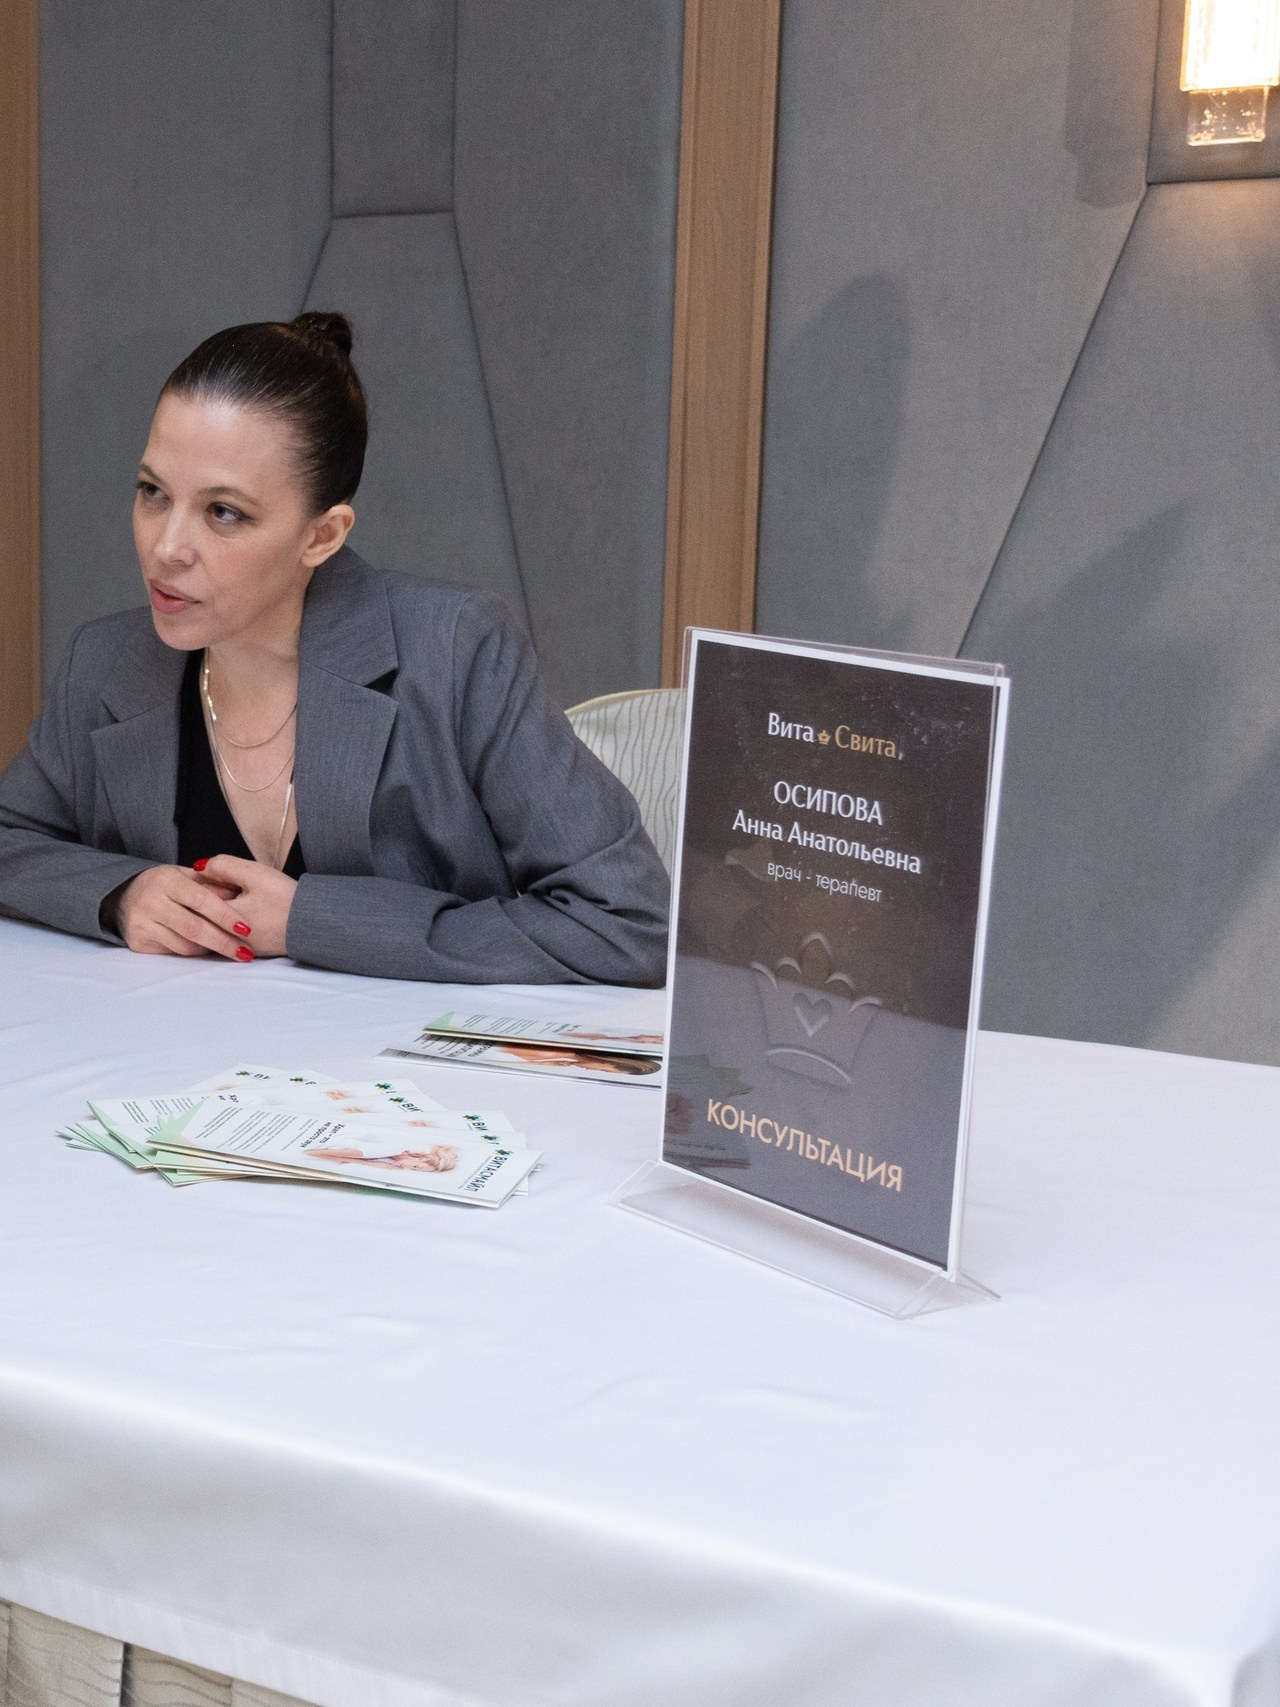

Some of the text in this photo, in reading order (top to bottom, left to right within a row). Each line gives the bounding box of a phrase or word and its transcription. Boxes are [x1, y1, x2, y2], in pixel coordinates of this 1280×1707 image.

[767, 712, 897, 759] Вита Свита
[773, 781, 883, 826] ОСИПОВА
[732, 809, 922, 875] Анна Анатольевна
[767, 862, 802, 883] врач
[816, 873, 882, 903] терапевт
[707, 1098, 904, 1193] КОНСУЛЬТАЦИЯ
[464, 1156, 508, 1192] ВИТАСМАЙЛ
